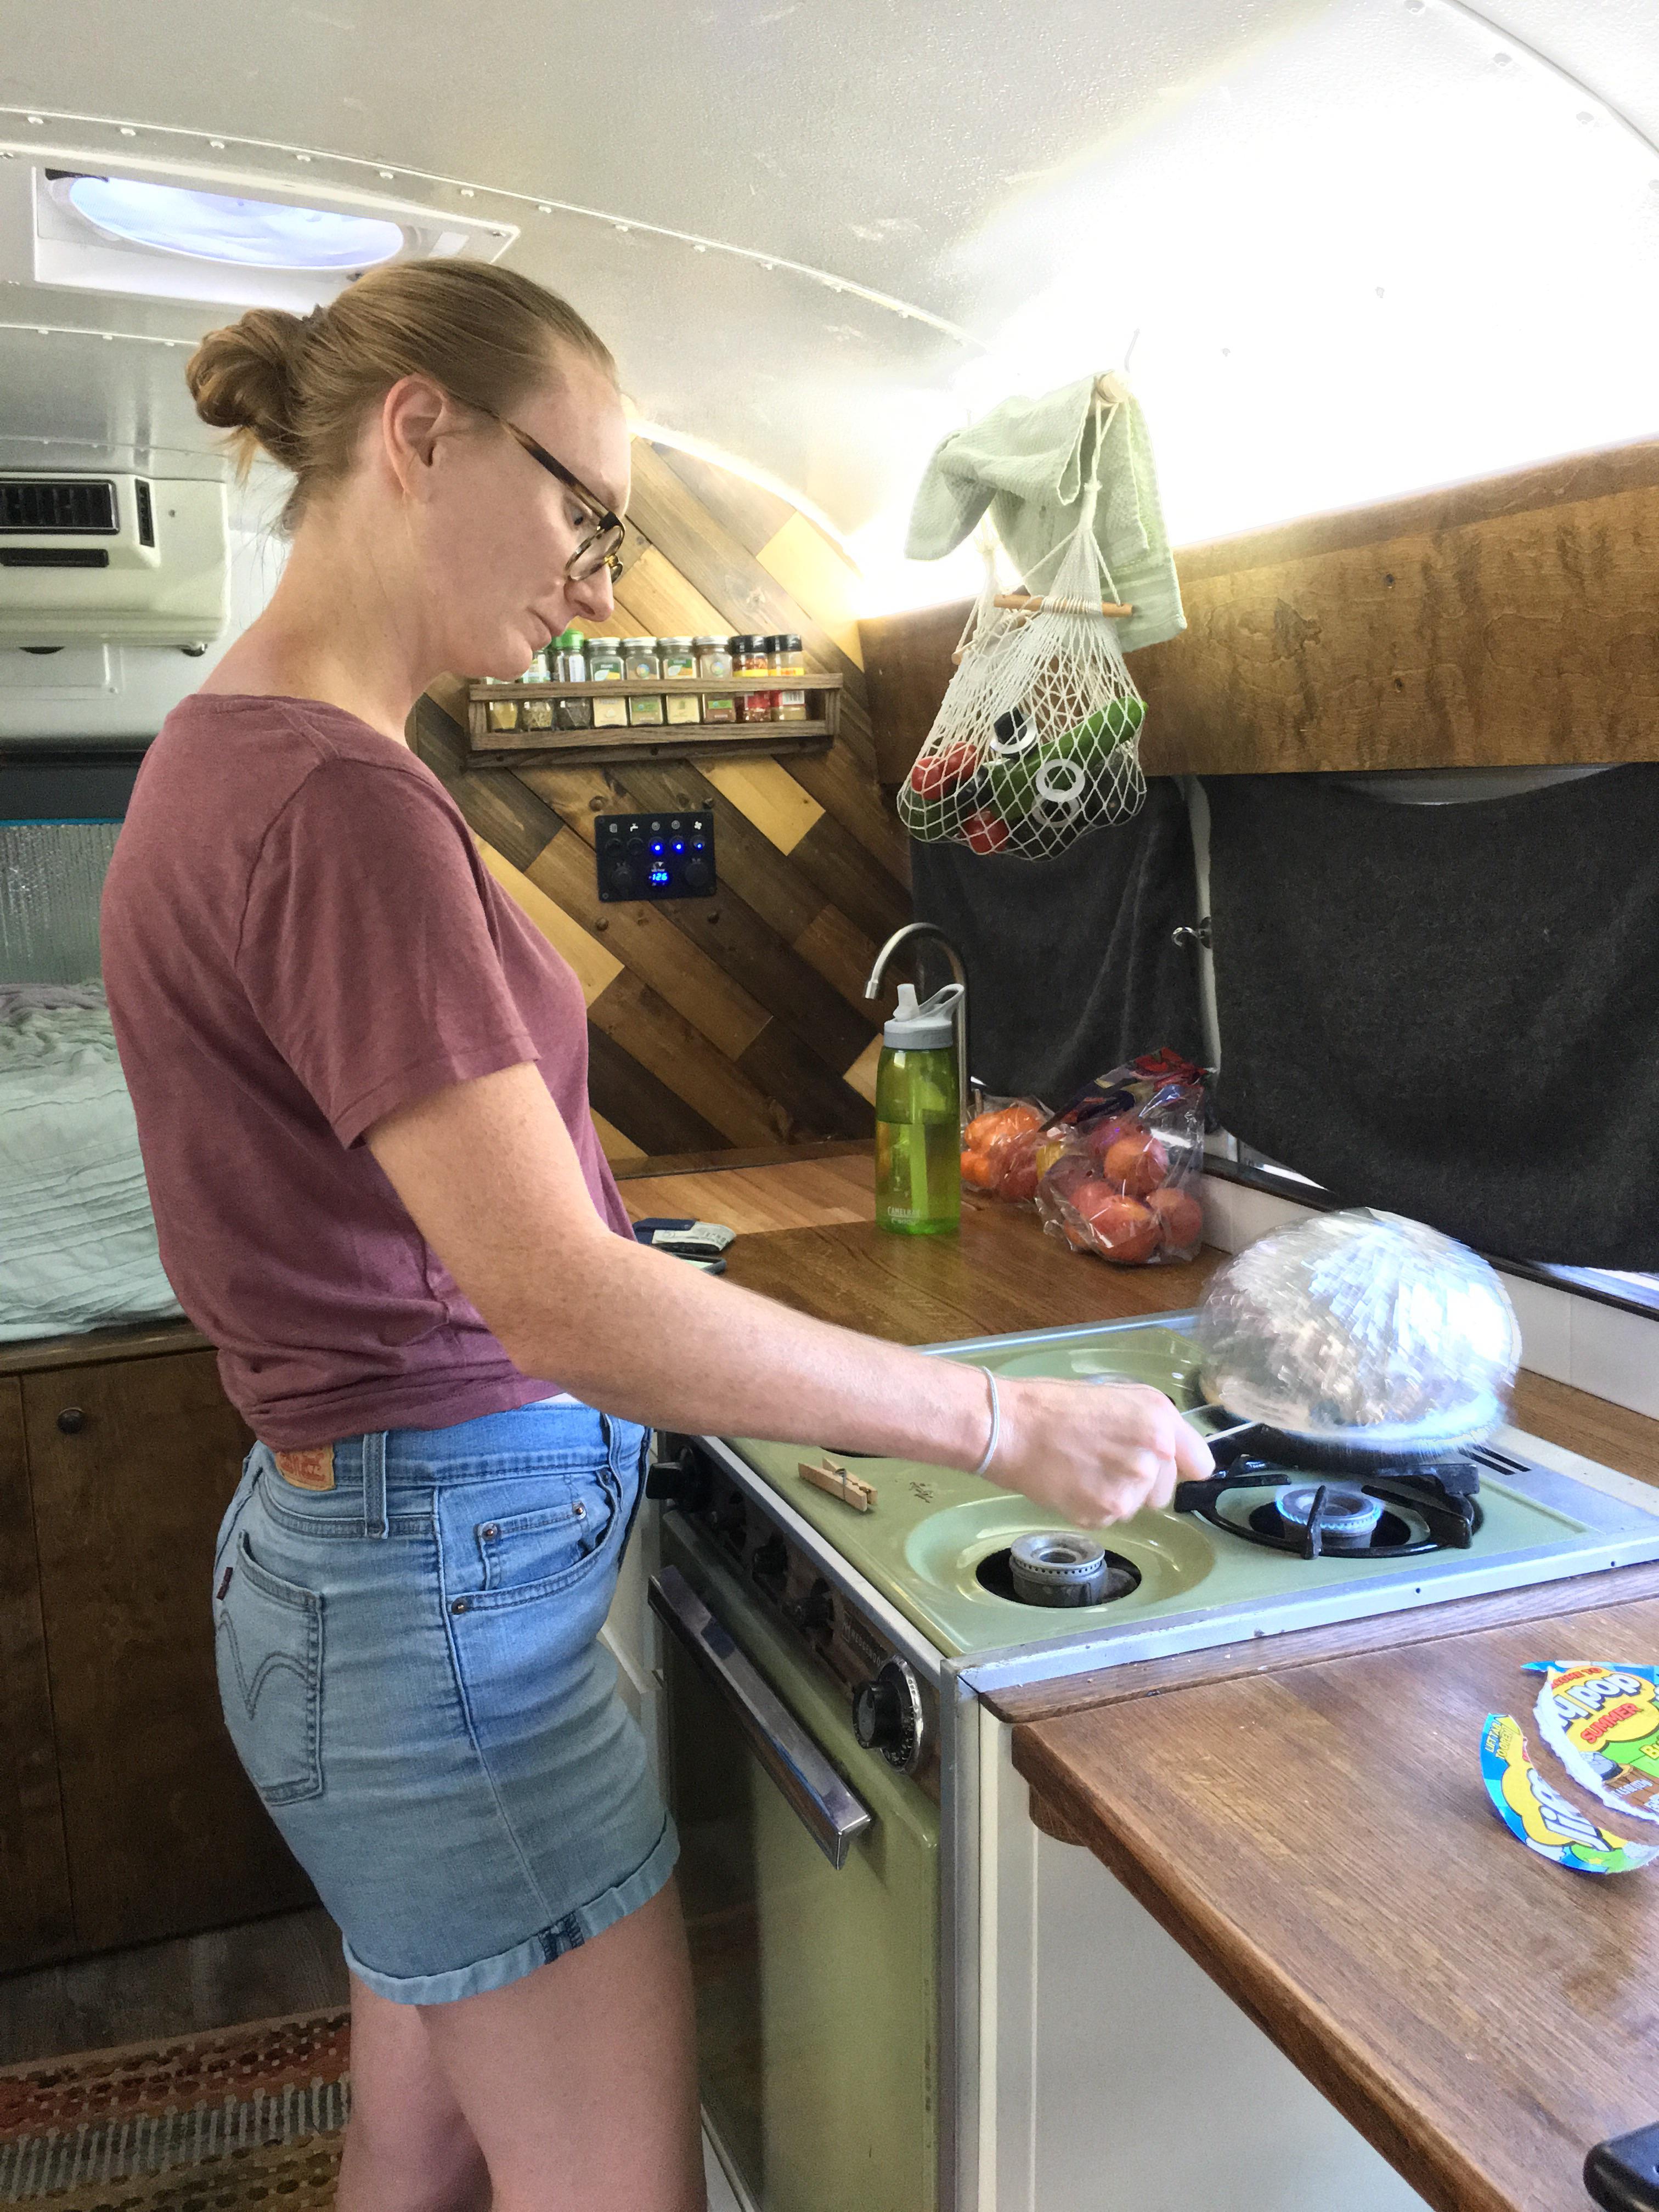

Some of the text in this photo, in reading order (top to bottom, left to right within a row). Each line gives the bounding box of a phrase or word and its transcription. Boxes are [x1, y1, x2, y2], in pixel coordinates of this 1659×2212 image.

[851, 1629, 884, 1667] WEDGEWOO
[1565, 1673, 1642, 1711] pop
[1485, 1722, 1502, 1753] LIFT TAB
[1581, 1703, 1643, 1743] SUMMER
[1495, 1748, 1507, 1760] TO
